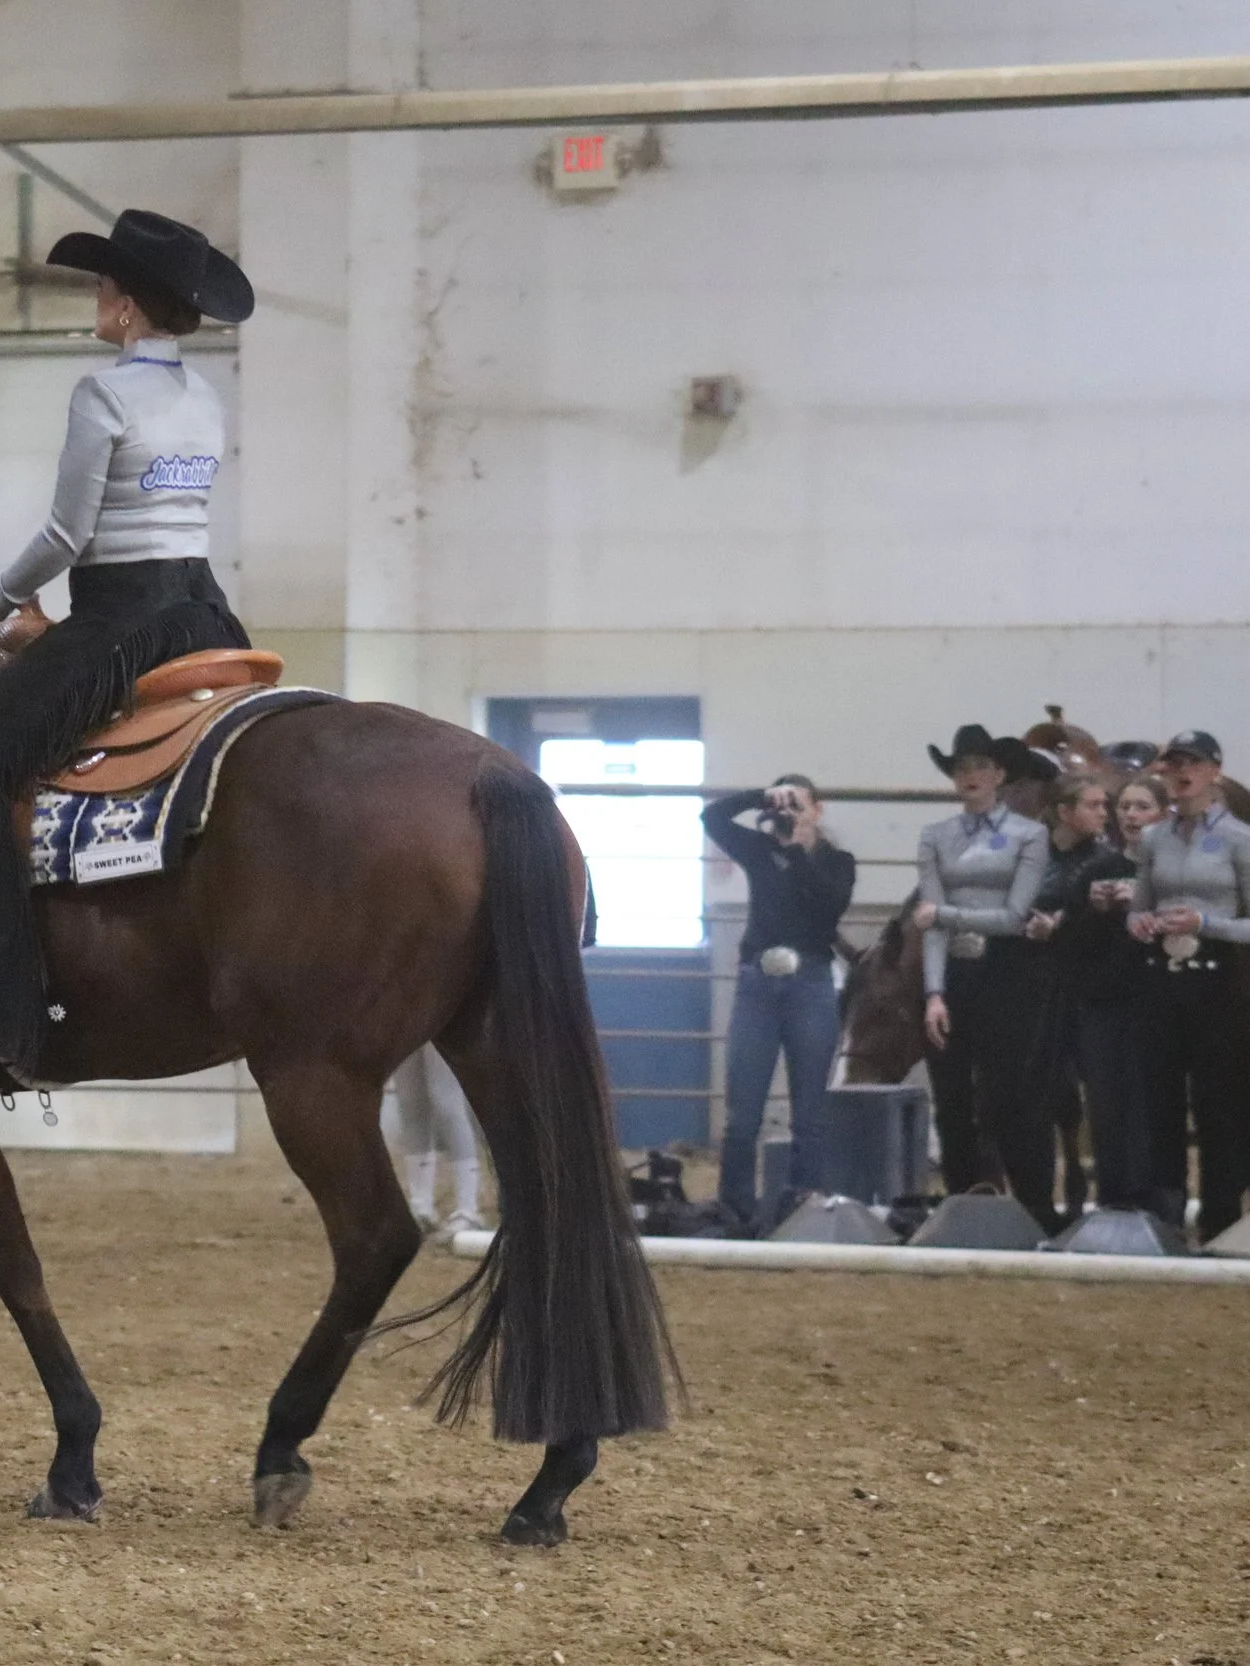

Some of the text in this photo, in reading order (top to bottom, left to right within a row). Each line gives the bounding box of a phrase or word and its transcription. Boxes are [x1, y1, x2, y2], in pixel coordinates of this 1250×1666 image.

[564, 136, 605, 173] EXIT
[94, 855, 142, 869] SWEET PEA
